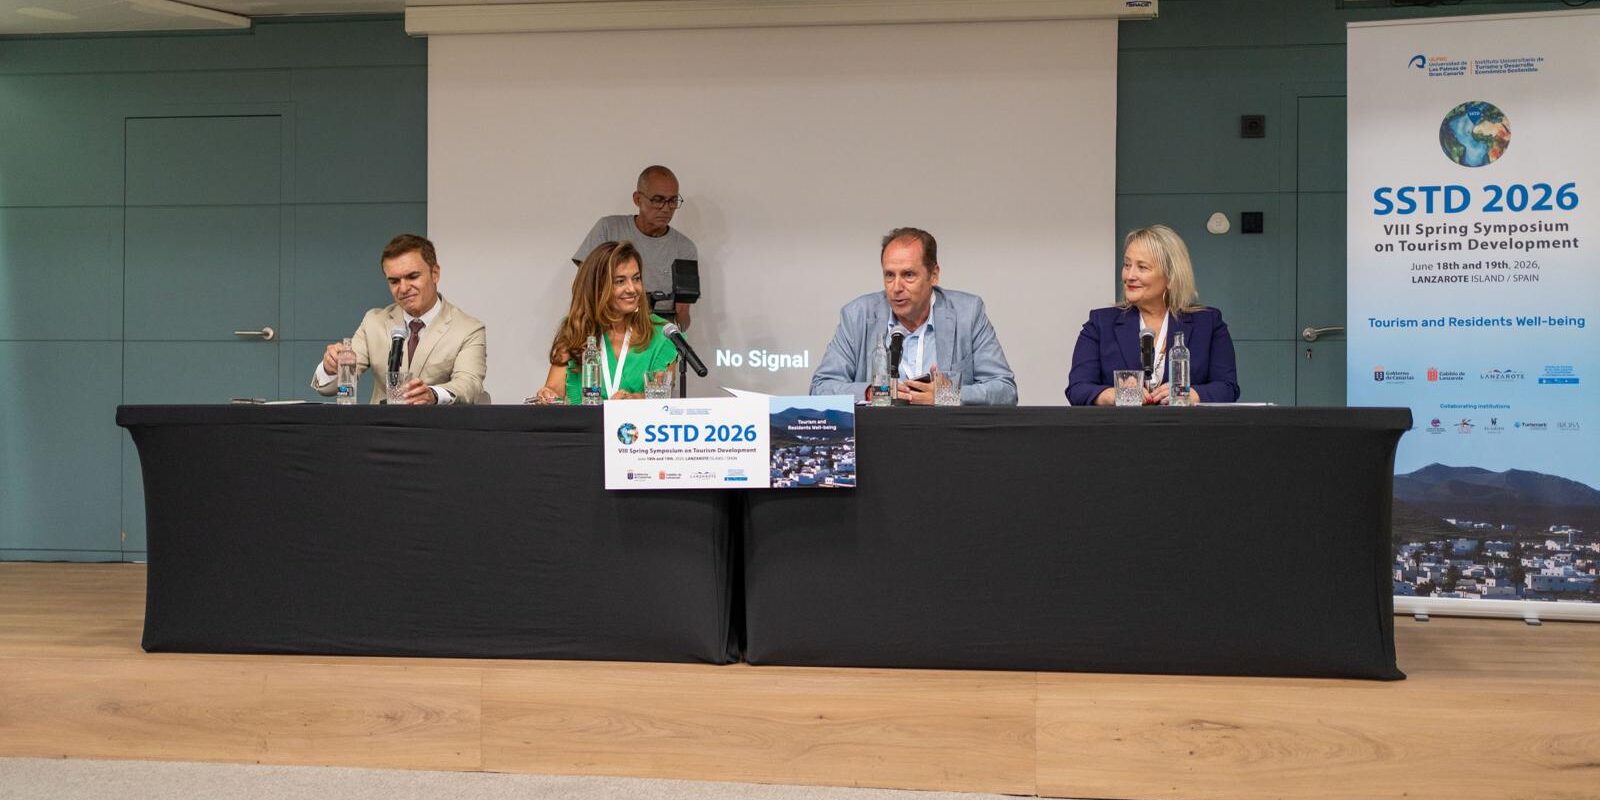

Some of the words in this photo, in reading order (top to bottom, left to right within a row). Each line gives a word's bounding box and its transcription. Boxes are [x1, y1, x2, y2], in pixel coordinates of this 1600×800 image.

[1374, 185, 1471, 216] SSTD
[1482, 182, 1579, 213] 2026
[1383, 224, 1410, 236] VIII
[1416, 222, 1468, 237] Spring
[1474, 220, 1570, 236] Symposium
[1374, 242, 1394, 252] on
[1398, 238, 1462, 252] Tourism
[1468, 236, 1580, 252] Development
[1410, 262, 1434, 271] June
[1436, 261, 1460, 270] 18th
[1462, 260, 1482, 270] and
[1485, 260, 1512, 271] 19th,
[1514, 260, 1540, 270] 2026,
[1412, 275, 1469, 284] LANZAROTE
[1471, 274, 1505, 283] ISLAND
[1513, 274, 1540, 282] SPAIN
[1368, 318, 1418, 328] Tourism
[1421, 317, 1445, 328] and
[1448, 316, 1512, 328] Residents
[1516, 316, 1586, 328] Well-being
[716, 349, 743, 367] No
[748, 350, 809, 372] Signal
[644, 424, 699, 443] SSTD
[704, 424, 757, 442] 2026
